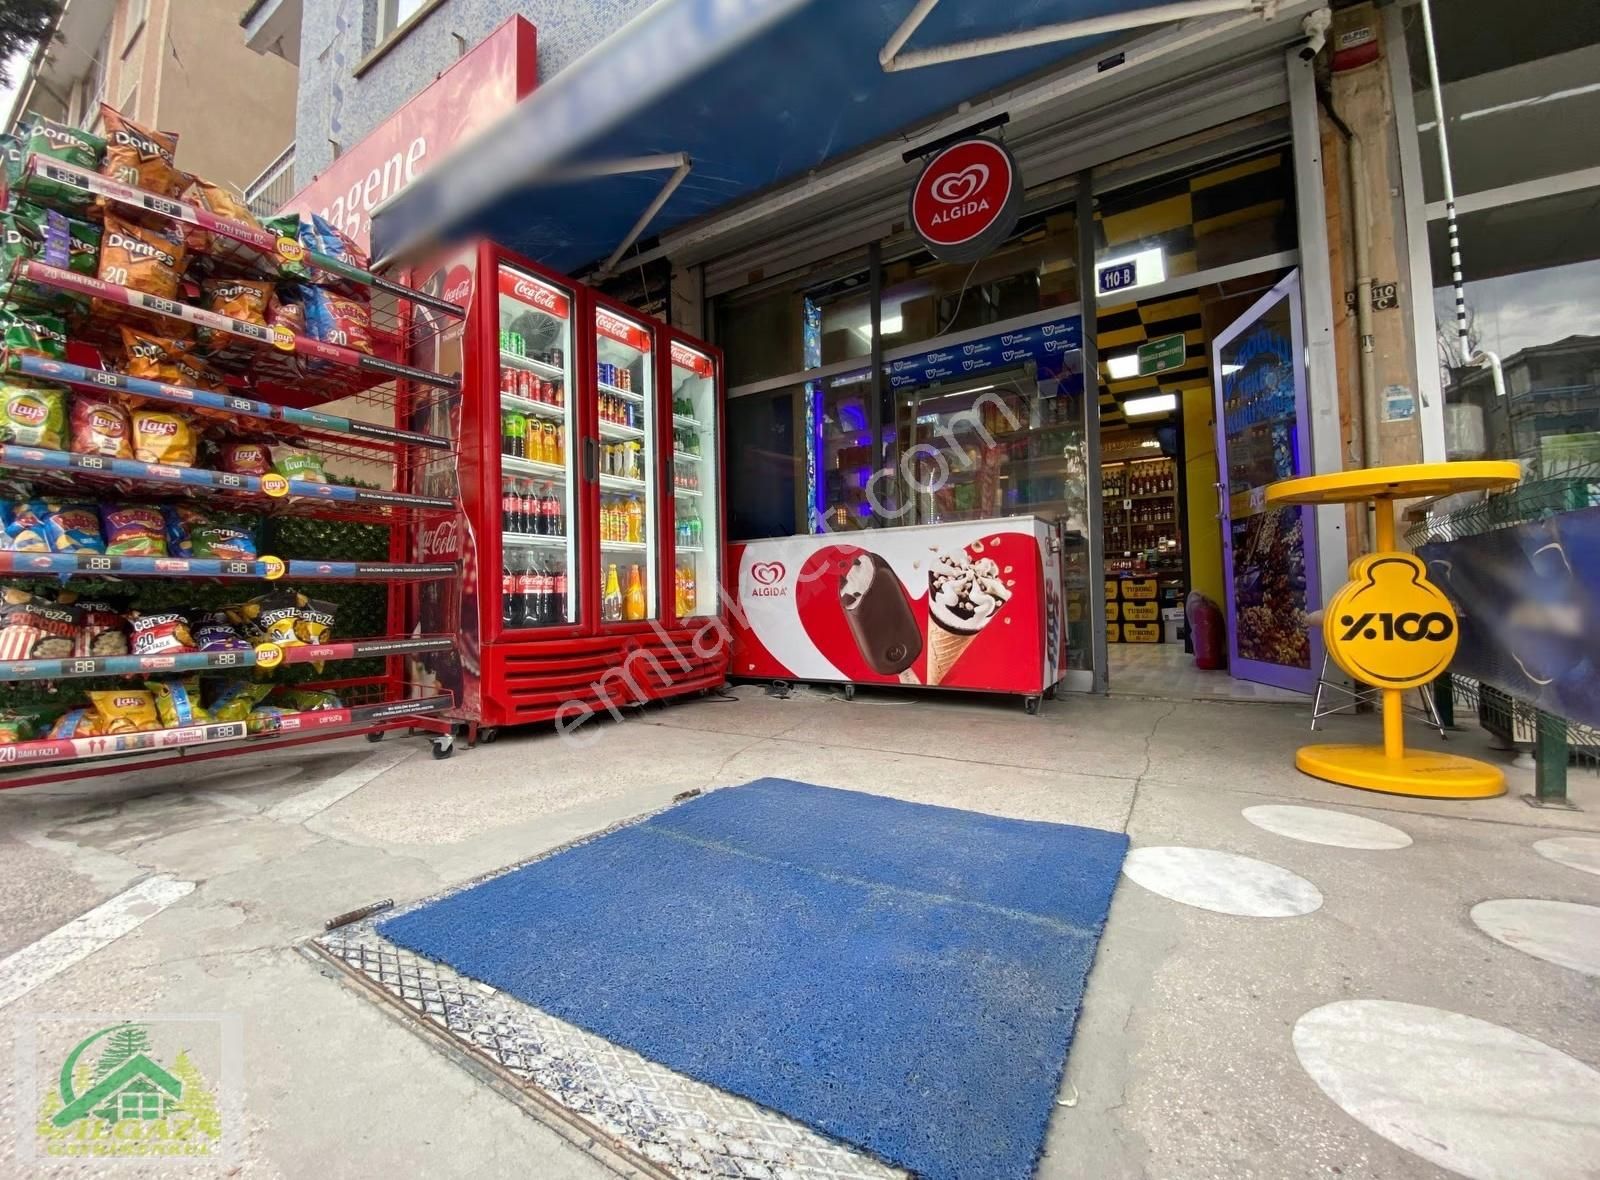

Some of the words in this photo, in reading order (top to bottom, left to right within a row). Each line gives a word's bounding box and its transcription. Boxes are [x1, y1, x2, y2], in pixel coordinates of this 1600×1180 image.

[109, 234, 175, 267] Doritos
[513, 280, 556, 310] Coca-Cola
[1340, 611, 1454, 642] %100
[38, 746, 60, 757] FAZLA
